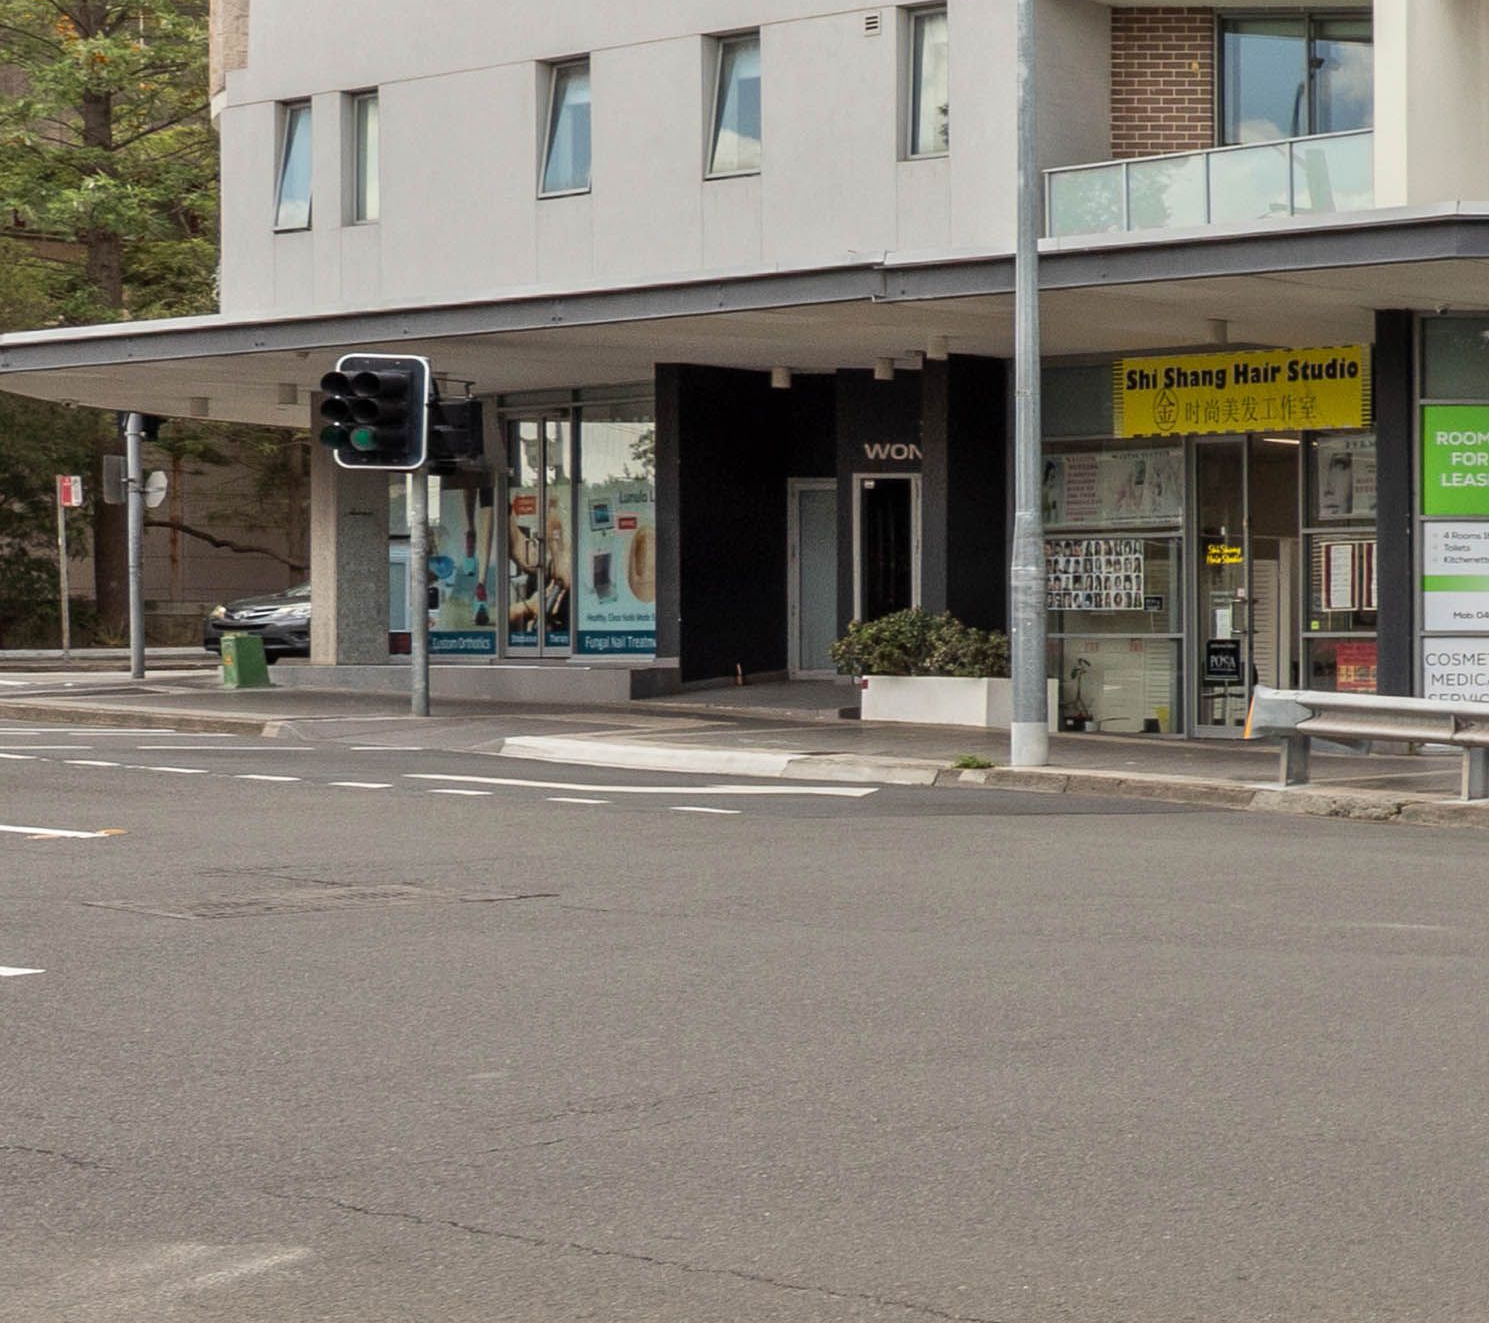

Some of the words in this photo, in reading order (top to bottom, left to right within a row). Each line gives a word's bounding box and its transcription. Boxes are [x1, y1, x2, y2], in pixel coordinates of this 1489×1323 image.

[1126, 369, 1157, 390] Shi
[1163, 366, 1227, 390] Shang
[1234, 362, 1281, 385] Hair
[1287, 357, 1359, 381] Studio
[1184, 393, 1318, 425] 时尚美发工作室
[1451, 452, 1489, 466] FOR
